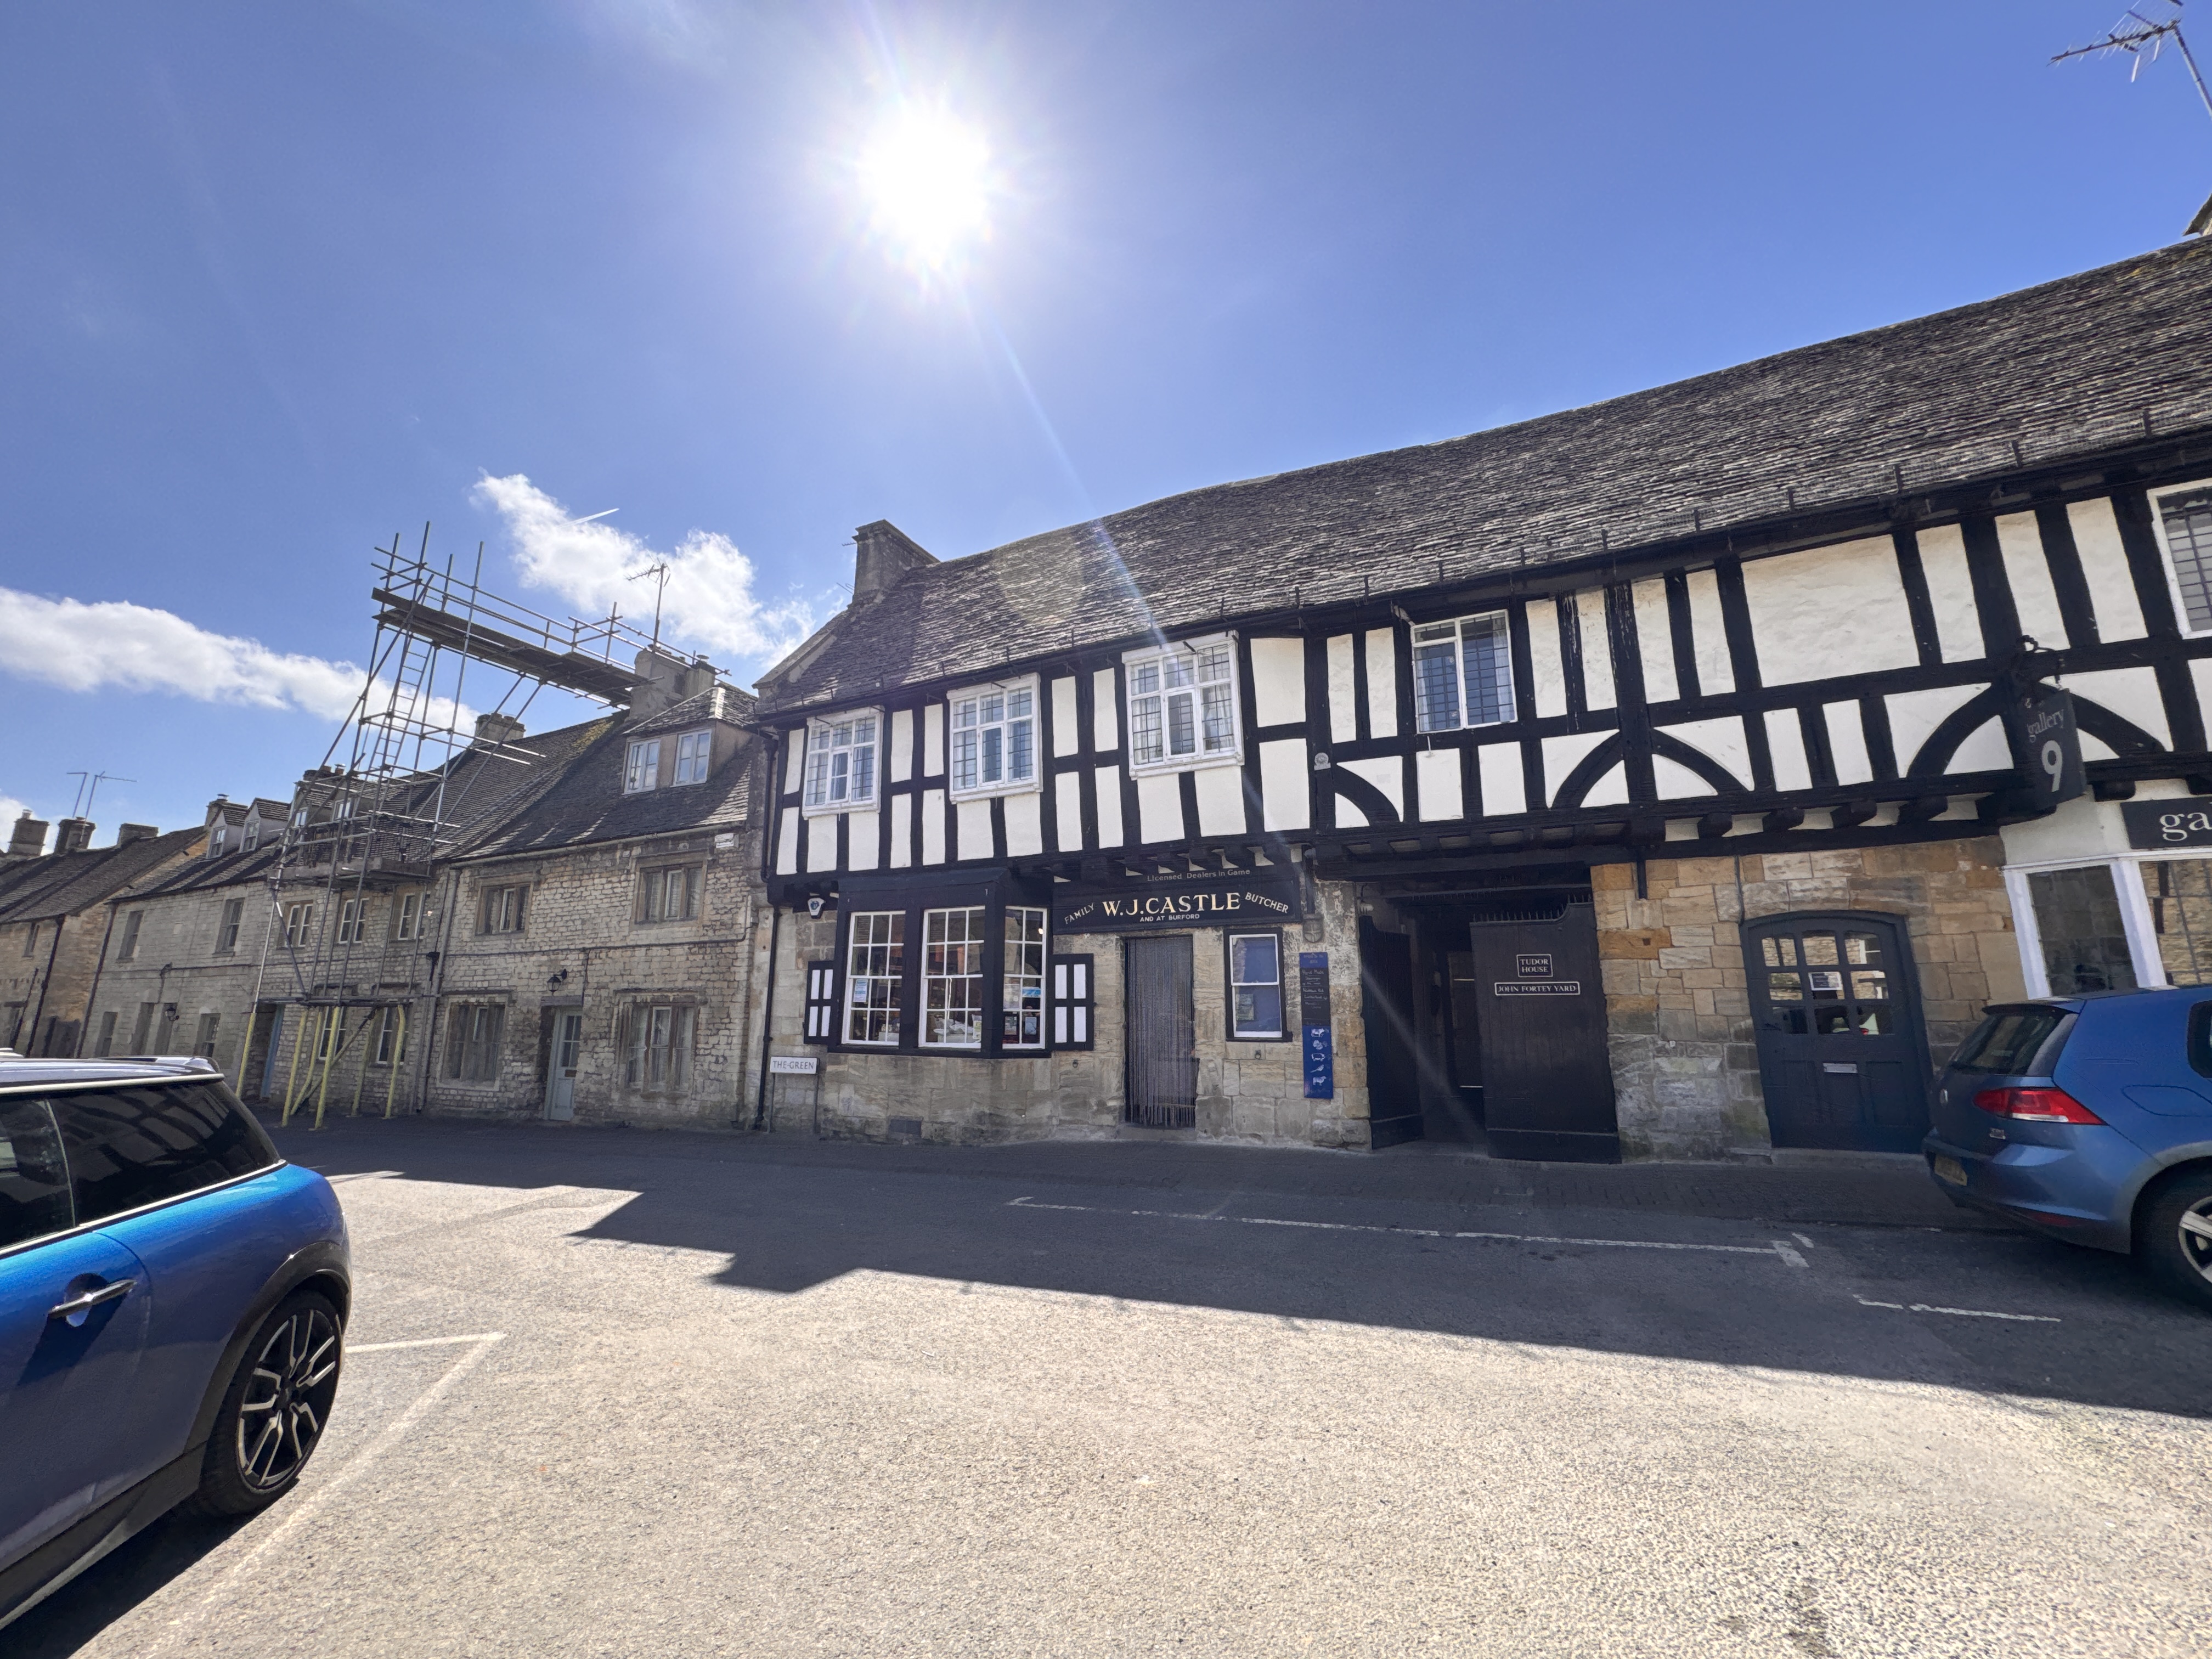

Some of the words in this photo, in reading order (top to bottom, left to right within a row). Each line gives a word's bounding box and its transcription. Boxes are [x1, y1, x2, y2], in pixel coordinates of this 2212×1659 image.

[2027, 709, 2064, 743] gallery
[2041, 740, 2063, 793] 9
[2159, 806, 2212, 842] ga
[1147, 873, 1182, 882] Licensed
[1064, 902, 1095, 924] FAMILY
[1245, 891, 1289, 914] BUTCHER
